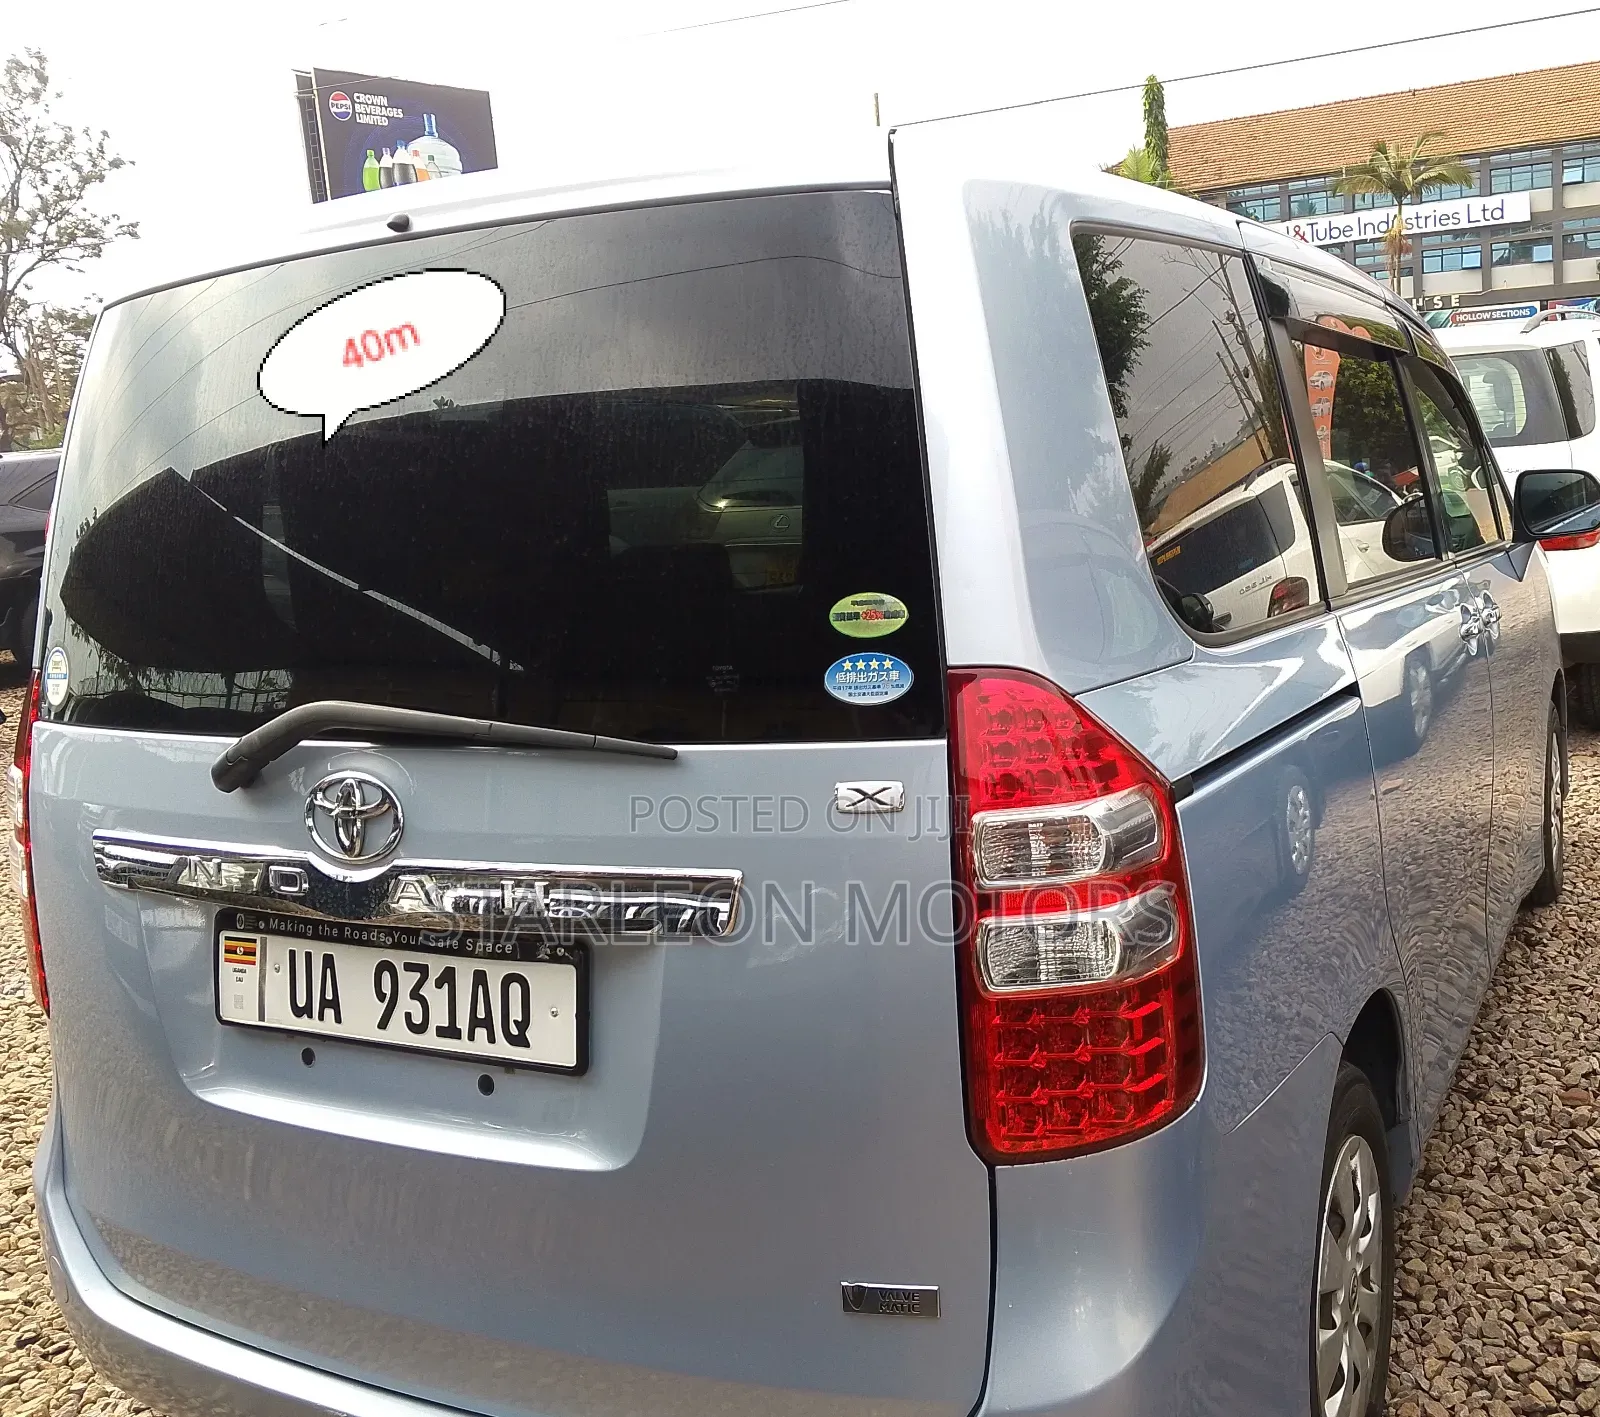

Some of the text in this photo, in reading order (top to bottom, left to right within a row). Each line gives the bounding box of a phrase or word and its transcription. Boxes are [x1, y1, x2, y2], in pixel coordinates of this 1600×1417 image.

[331, 101, 351, 111] PEPSI
[353, 93, 388, 107] CROWN
[355, 103, 404, 119] BEVERAGES
[356, 113, 389, 126] LIMITED
[1467, 199, 1505, 224] Ltd
[1456, 308, 1531, 322] HOLLOW SECTIONS
[836, 670, 900, 684] 低排出ガス車
[846, 787, 894, 808] X
[269, 918, 313, 936] Making
[318, 924, 338, 937] the
[344, 927, 385, 942] Roads
[393, 931, 423, 945] Your
[429, 935, 459, 949] Safe
[466, 939, 513, 955] Space
[288, 948, 532, 1049] UA 931AQ
[878, 1290, 920, 1303] VALVE
[879, 1302, 920, 1314] MATIC
